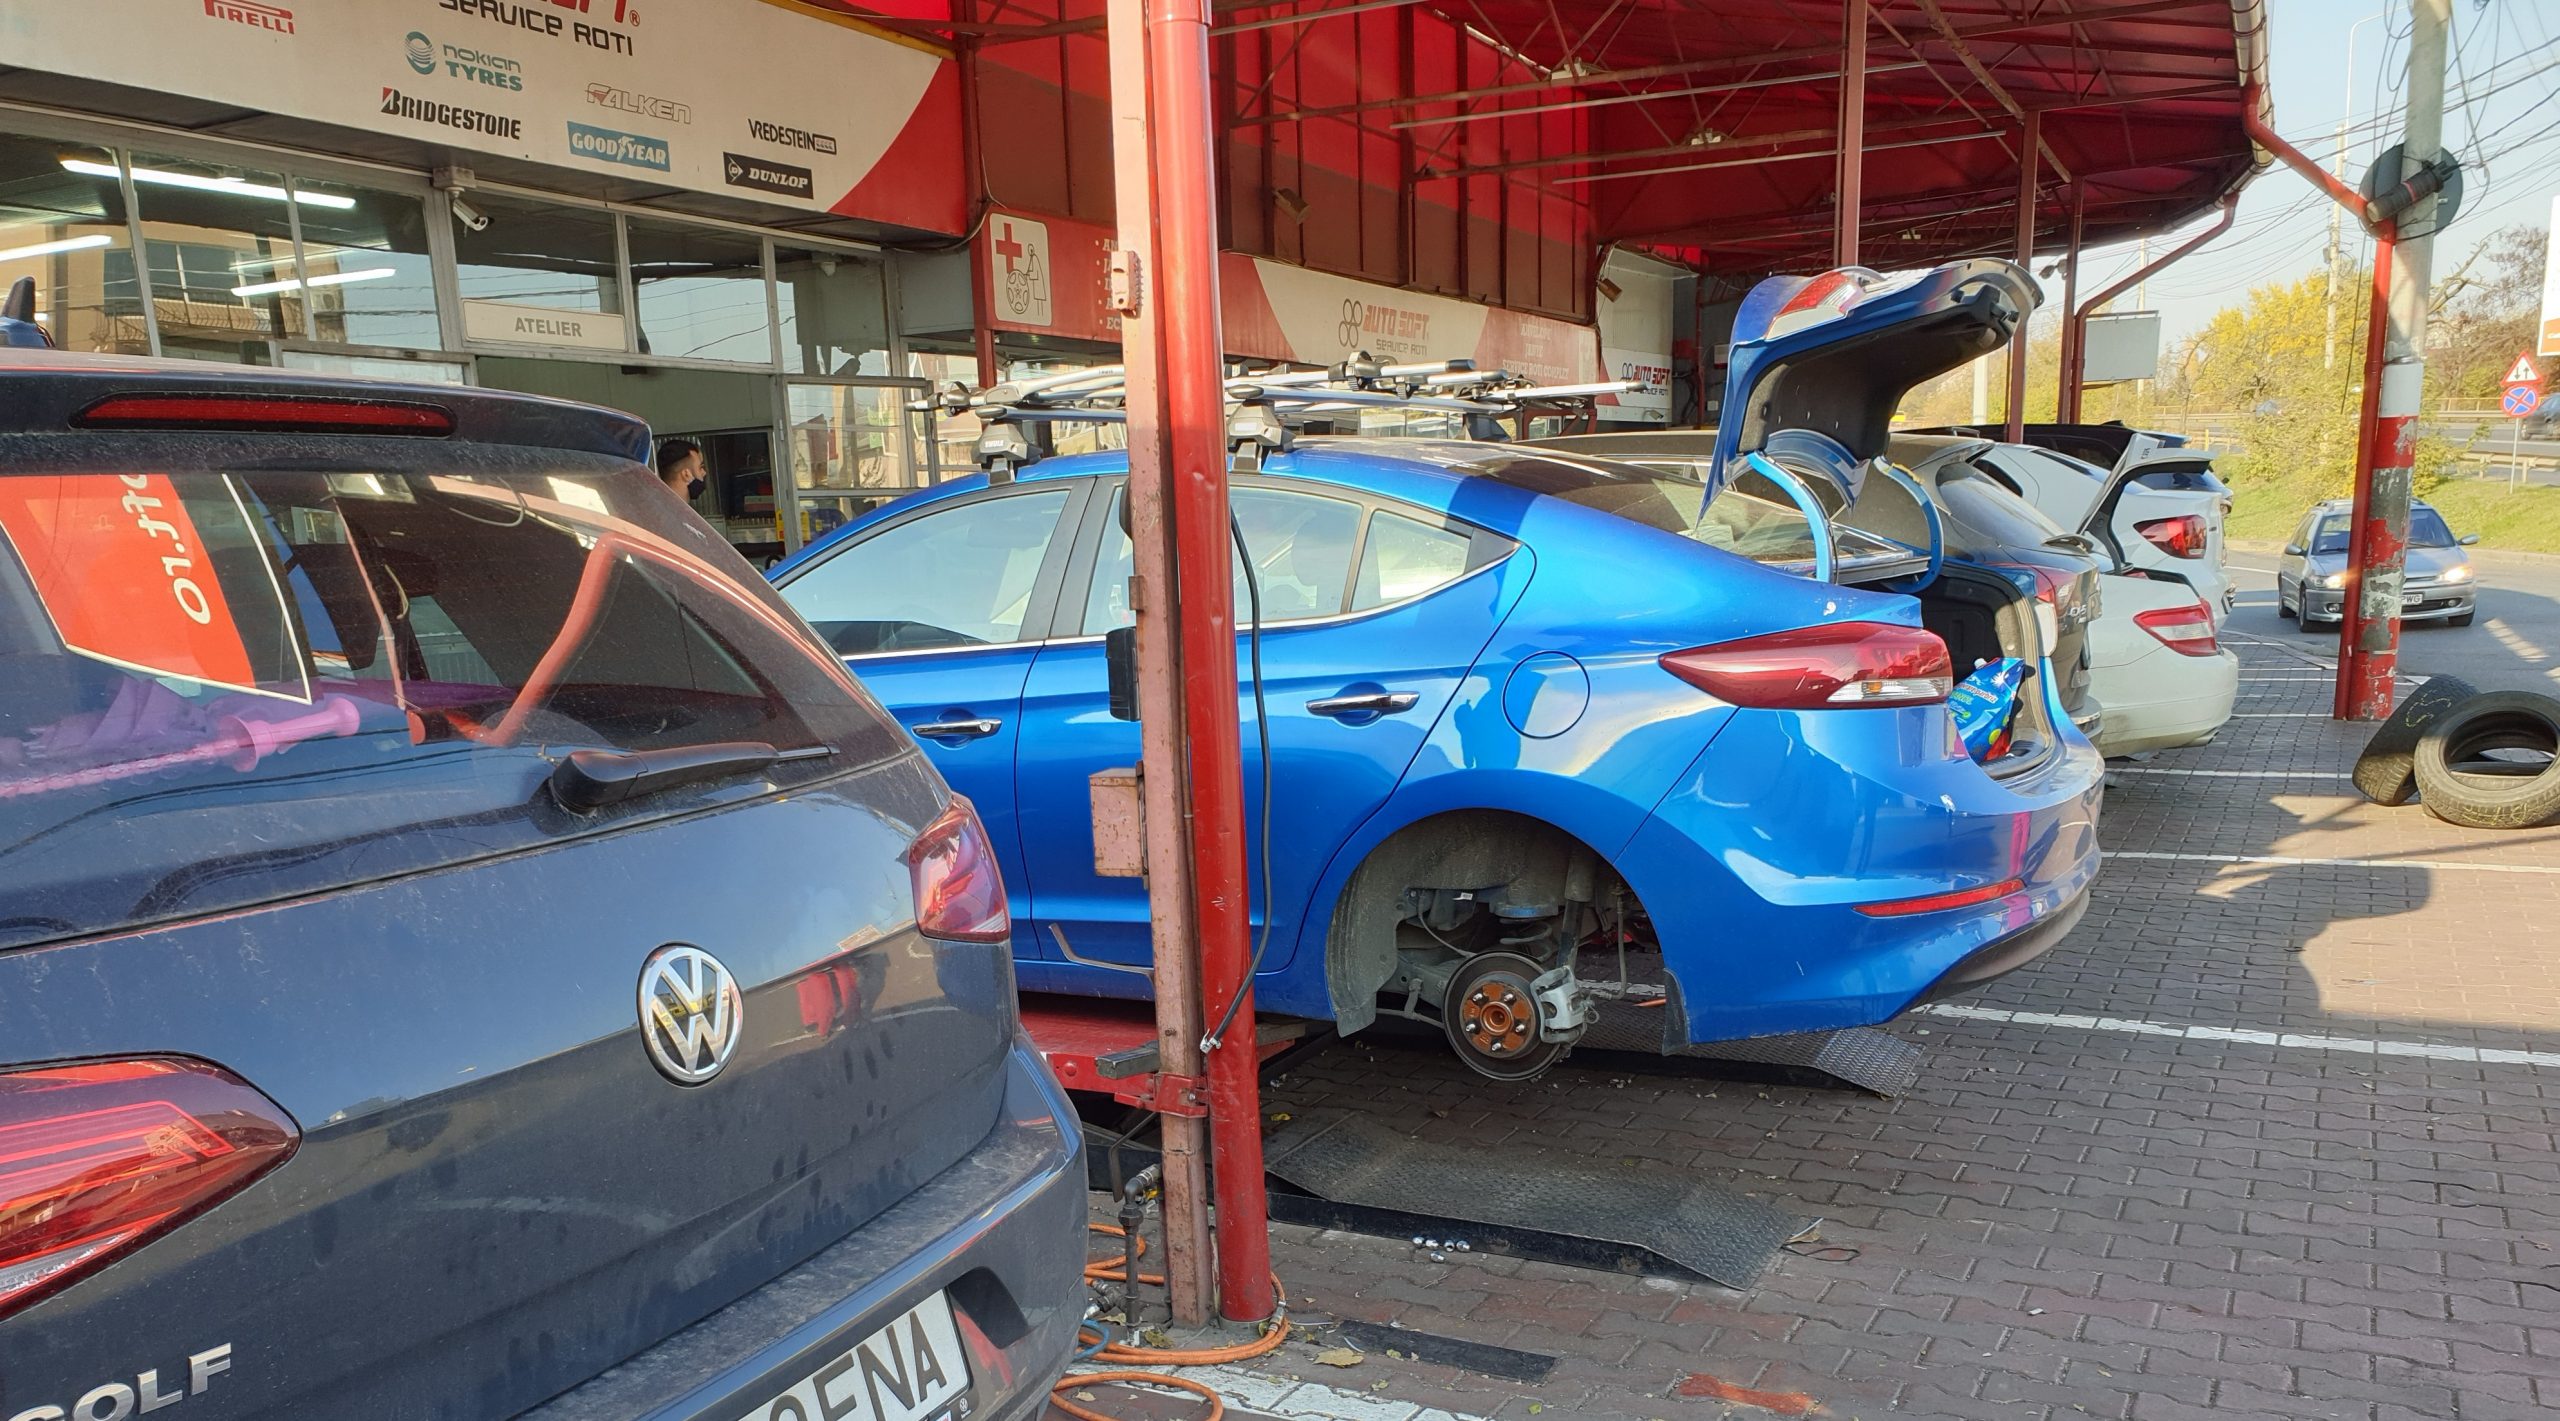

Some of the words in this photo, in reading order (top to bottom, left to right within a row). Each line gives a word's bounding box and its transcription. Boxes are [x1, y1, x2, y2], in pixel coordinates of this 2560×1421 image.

[203, 0, 294, 34] PIRELLI
[573, 22, 633, 56] ROTI
[445, 60, 522, 92] TYRES
[381, 87, 521, 140] BRIDGESTONE
[585, 82, 691, 125] FALKEN
[572, 132, 667, 166] GOODYEAR
[748, 118, 817, 151] VREDESTEIN
[749, 167, 808, 189] DUNLOP
[515, 317, 582, 337] ATELIER
[1362, 304, 1397, 336] AUTO
[1398, 310, 1430, 341] SOFT
[1652, 367, 1670, 385] SOFT
